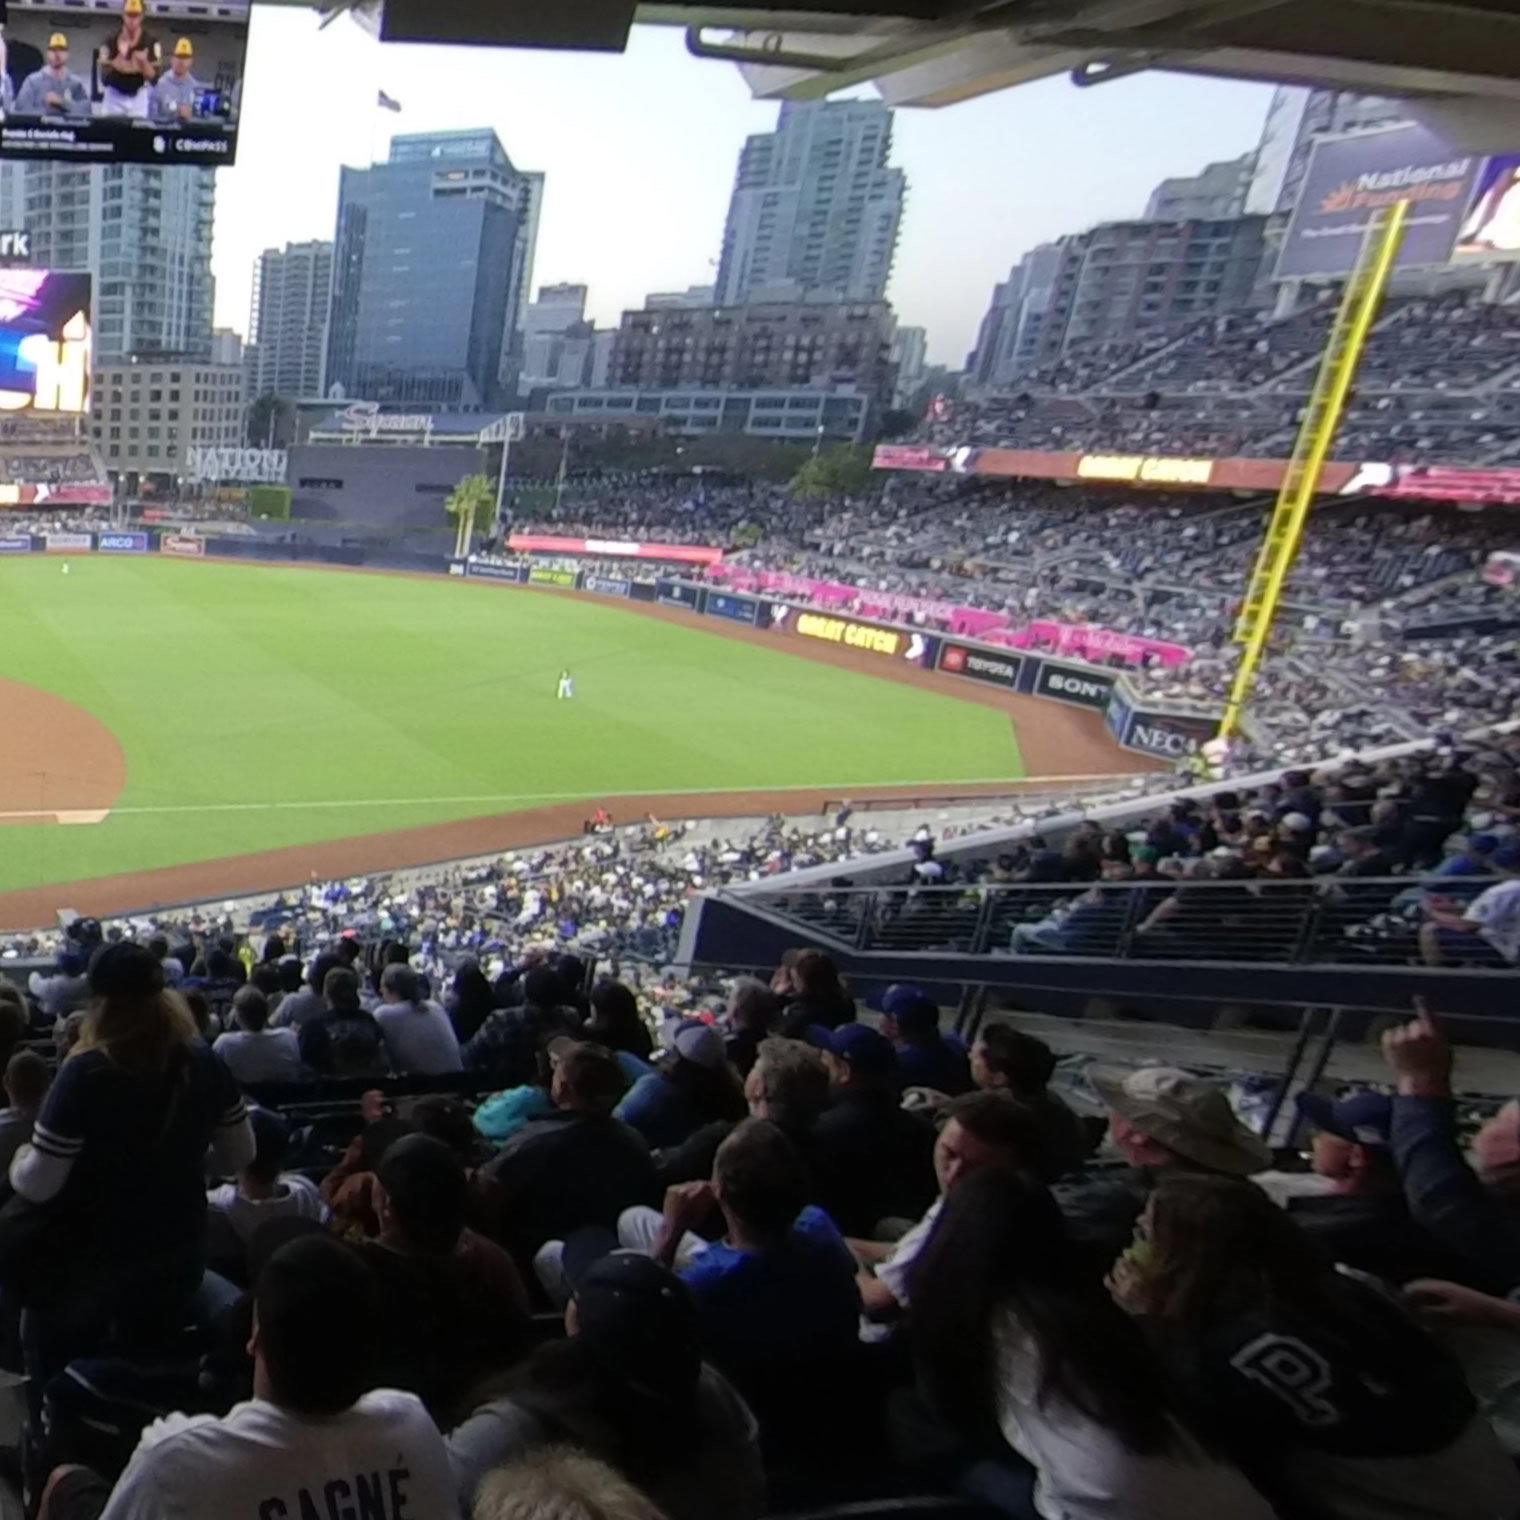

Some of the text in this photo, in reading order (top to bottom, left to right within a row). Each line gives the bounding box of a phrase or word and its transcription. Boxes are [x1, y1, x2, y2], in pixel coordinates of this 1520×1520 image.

[1358, 158, 1471, 190] National
[99, 537, 133, 549] ARCO
[796, 614, 899, 655] GREAT CATCH
[967, 656, 1013, 679] TOYOTA
